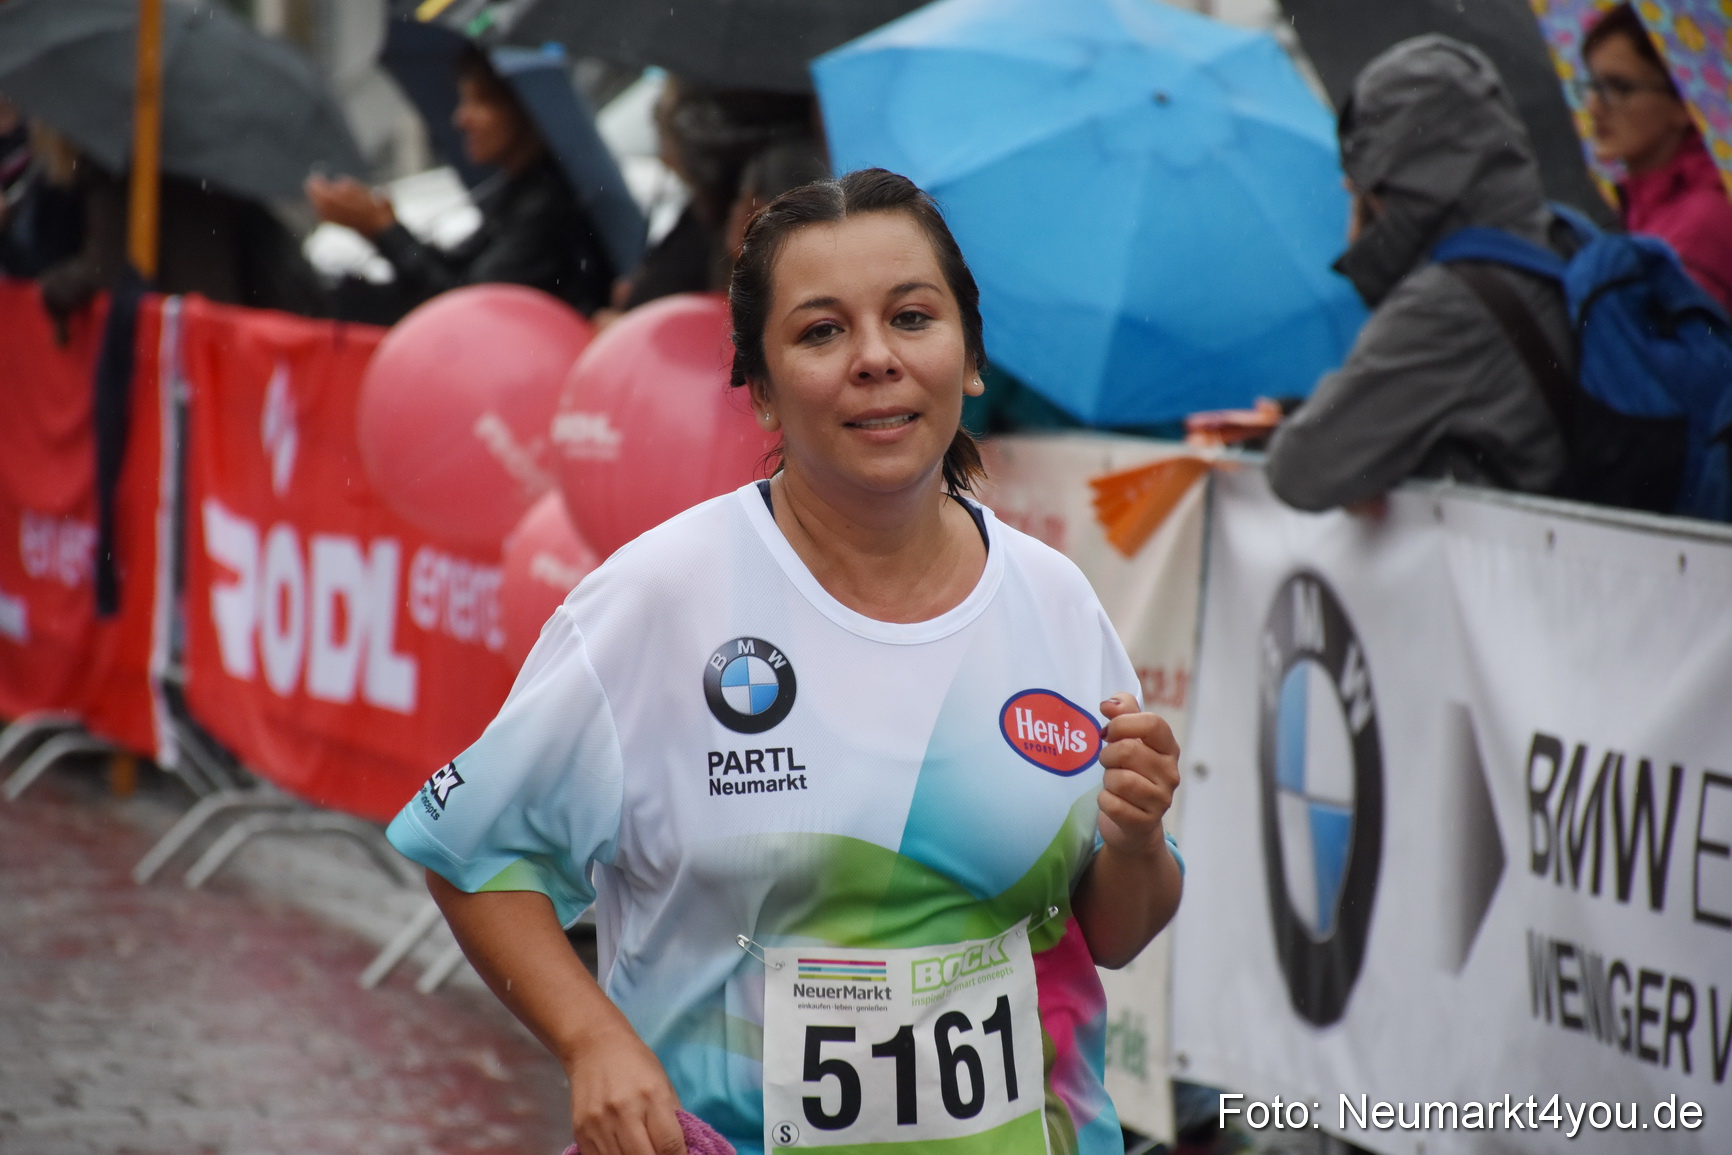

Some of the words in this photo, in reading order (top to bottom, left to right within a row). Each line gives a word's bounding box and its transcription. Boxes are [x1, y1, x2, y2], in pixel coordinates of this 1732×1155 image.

[709, 639, 788, 672] BMW
[1015, 706, 1088, 755] Hervis
[707, 747, 806, 777] PARTL
[1023, 741, 1057, 756] SPORTS
[709, 773, 808, 797] Neumarkt
[1526, 730, 1685, 914] BMW
[911, 932, 1010, 994] BOCK
[977, 966, 1014, 985] concepts
[793, 983, 893, 1001] NeuerMarkt
[797, 1002, 831, 1011] einkaufen
[834, 1003, 853, 1011] leben
[802, 994, 1019, 1131] 5161
[780, 1124, 792, 1144] S
